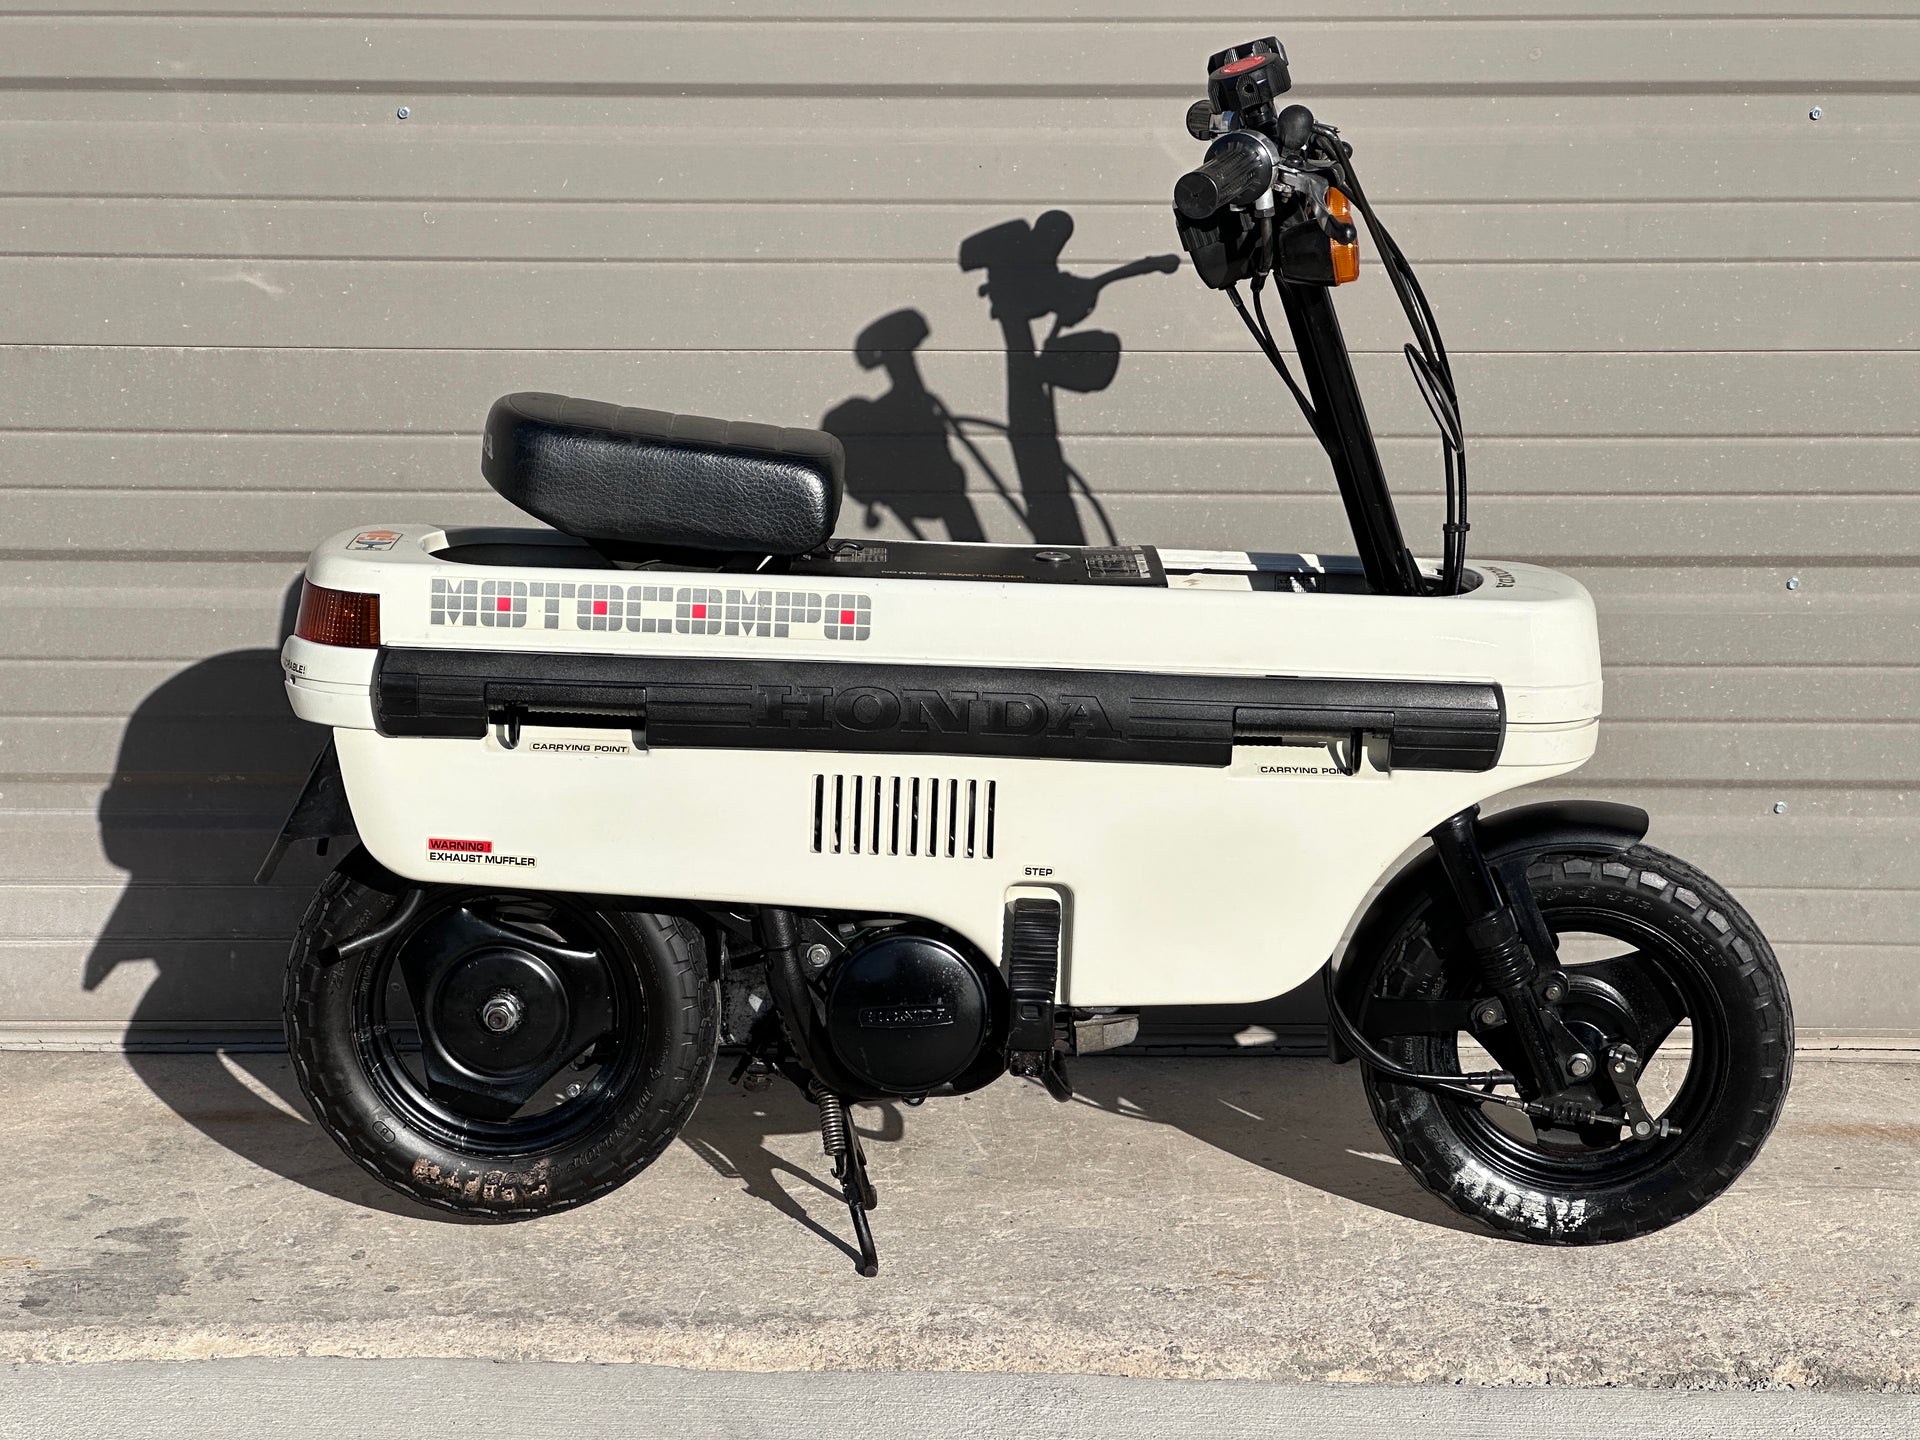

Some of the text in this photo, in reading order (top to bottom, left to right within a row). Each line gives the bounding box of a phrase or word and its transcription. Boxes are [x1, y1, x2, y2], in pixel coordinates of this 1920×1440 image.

[430, 578, 871, 641] MOTOCOMPO
[756, 685, 1123, 740] HONDA
[532, 743, 628, 753] CARRYING POINT
[1260, 766, 1318, 774] CARRYING
[431, 841, 484, 852] WARNING
[429, 852, 536, 866] EXHAUST MUFFLER
[1024, 867, 1053, 876] STEP
